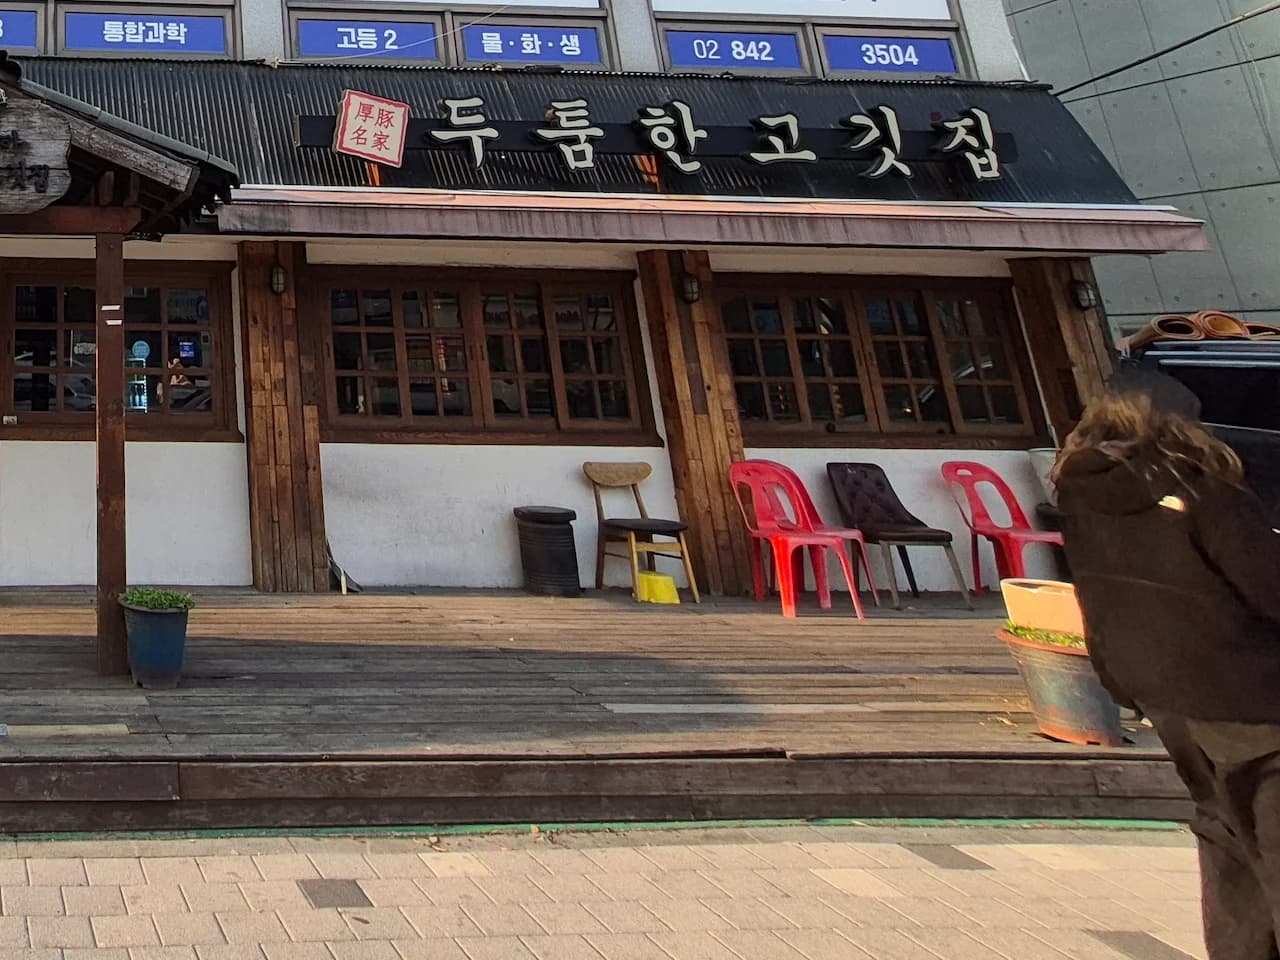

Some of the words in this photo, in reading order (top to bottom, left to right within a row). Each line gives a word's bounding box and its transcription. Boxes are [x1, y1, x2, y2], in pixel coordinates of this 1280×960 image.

[102, 20, 188, 45] 통합과학
[336, 27, 378, 51] 고등
[383, 29, 399, 51] 2
[693, 38, 721, 60] 02
[731, 39, 774, 62] 842
[861, 43, 919, 66] 3504
